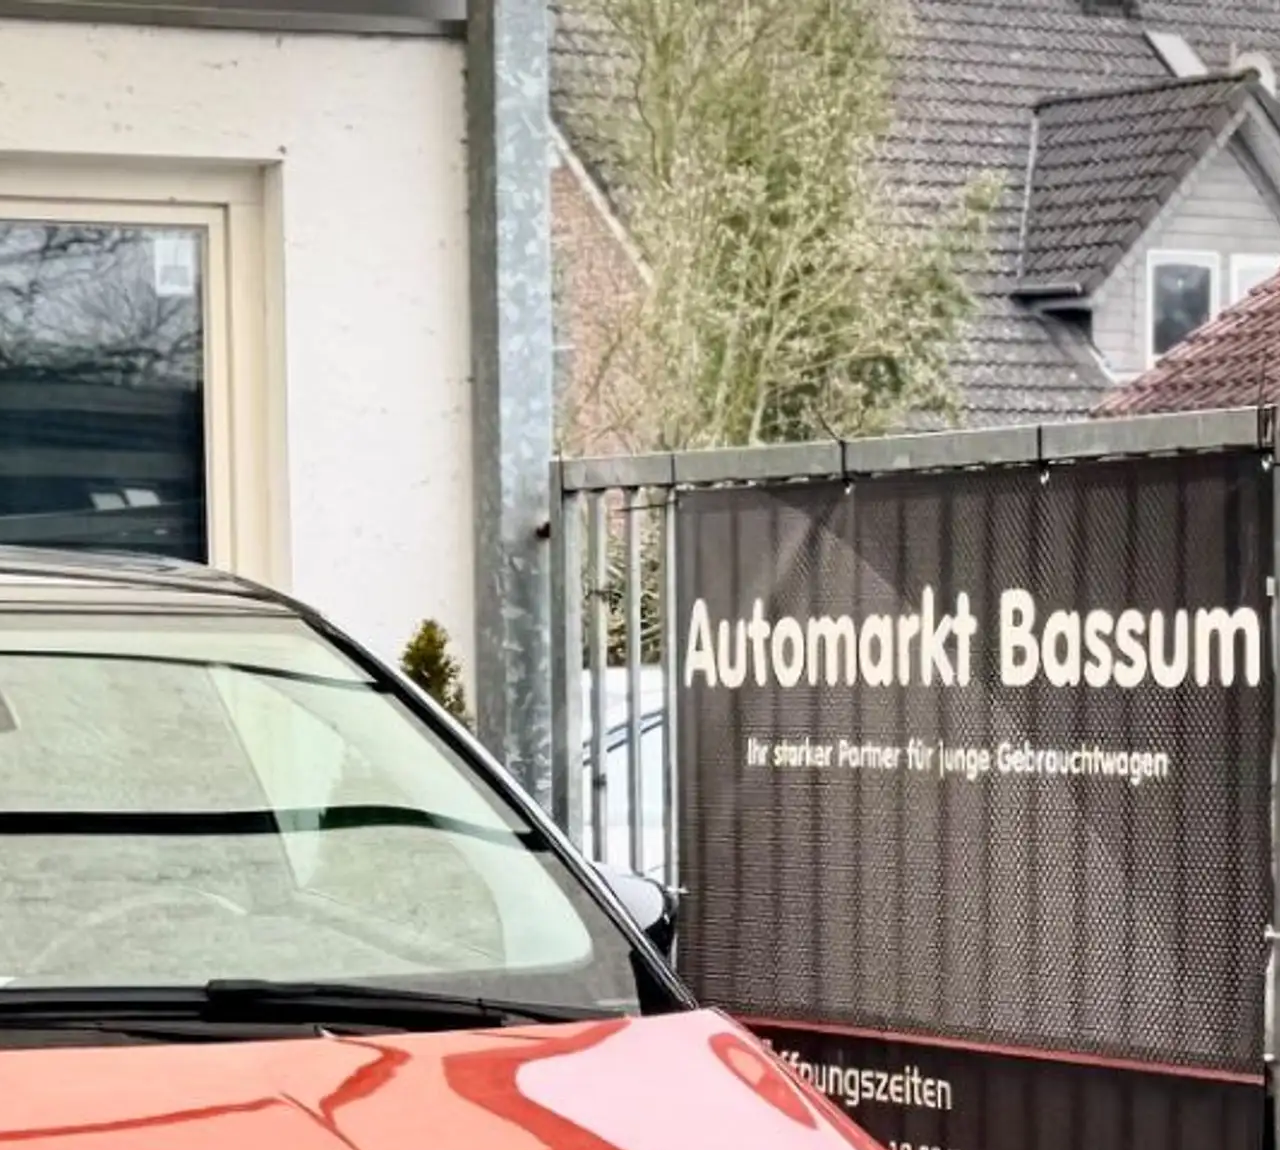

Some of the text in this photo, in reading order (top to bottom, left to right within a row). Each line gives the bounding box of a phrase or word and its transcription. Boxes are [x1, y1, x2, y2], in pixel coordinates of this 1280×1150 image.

[684, 583, 1261, 688] Automarkt Bassum
[747, 736, 1168, 786] Ihr starker Partner für junge Gebrauchtwagen
[761, 1038, 952, 1110] ffnungszeiten
